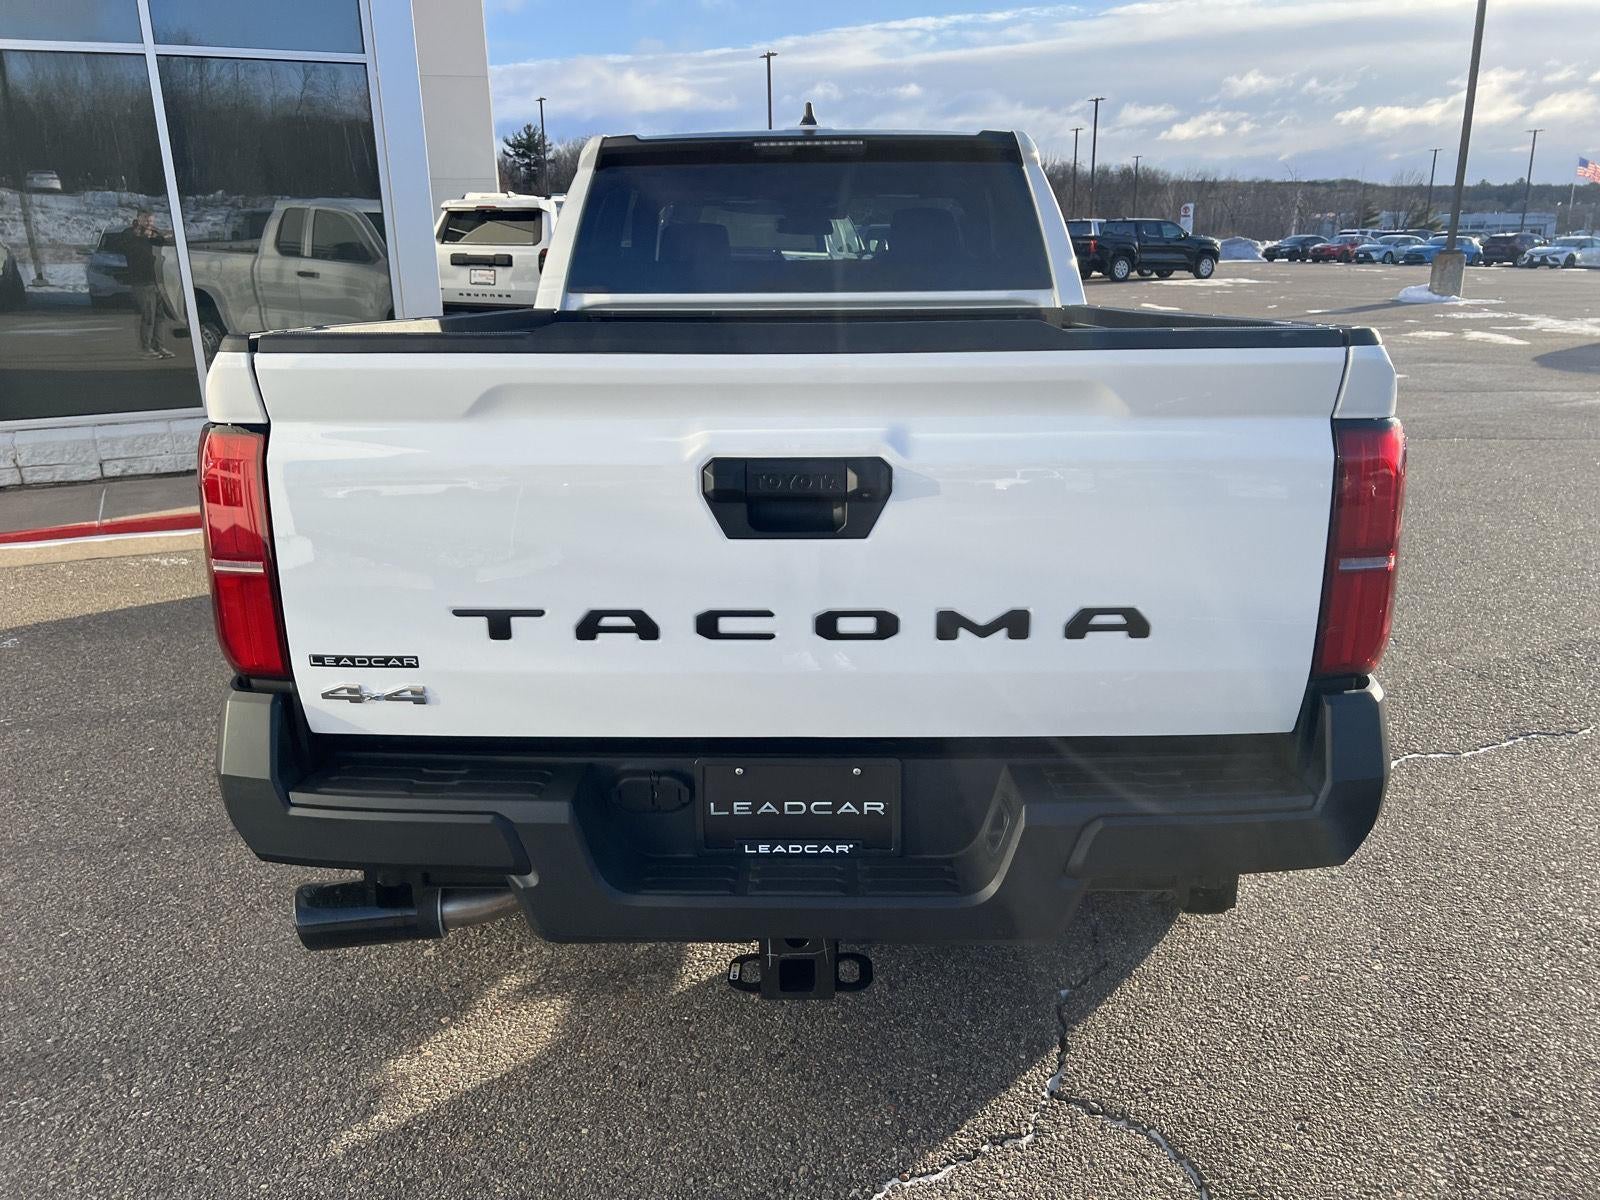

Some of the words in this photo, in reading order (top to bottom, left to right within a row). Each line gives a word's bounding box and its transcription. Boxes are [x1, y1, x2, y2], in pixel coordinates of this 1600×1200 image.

[452, 607, 1151, 641] TACOMA
[309, 655, 418, 667] LEADCAR
[710, 801, 885, 815] LEADCAR
[745, 844, 850, 853] LEADCAR
